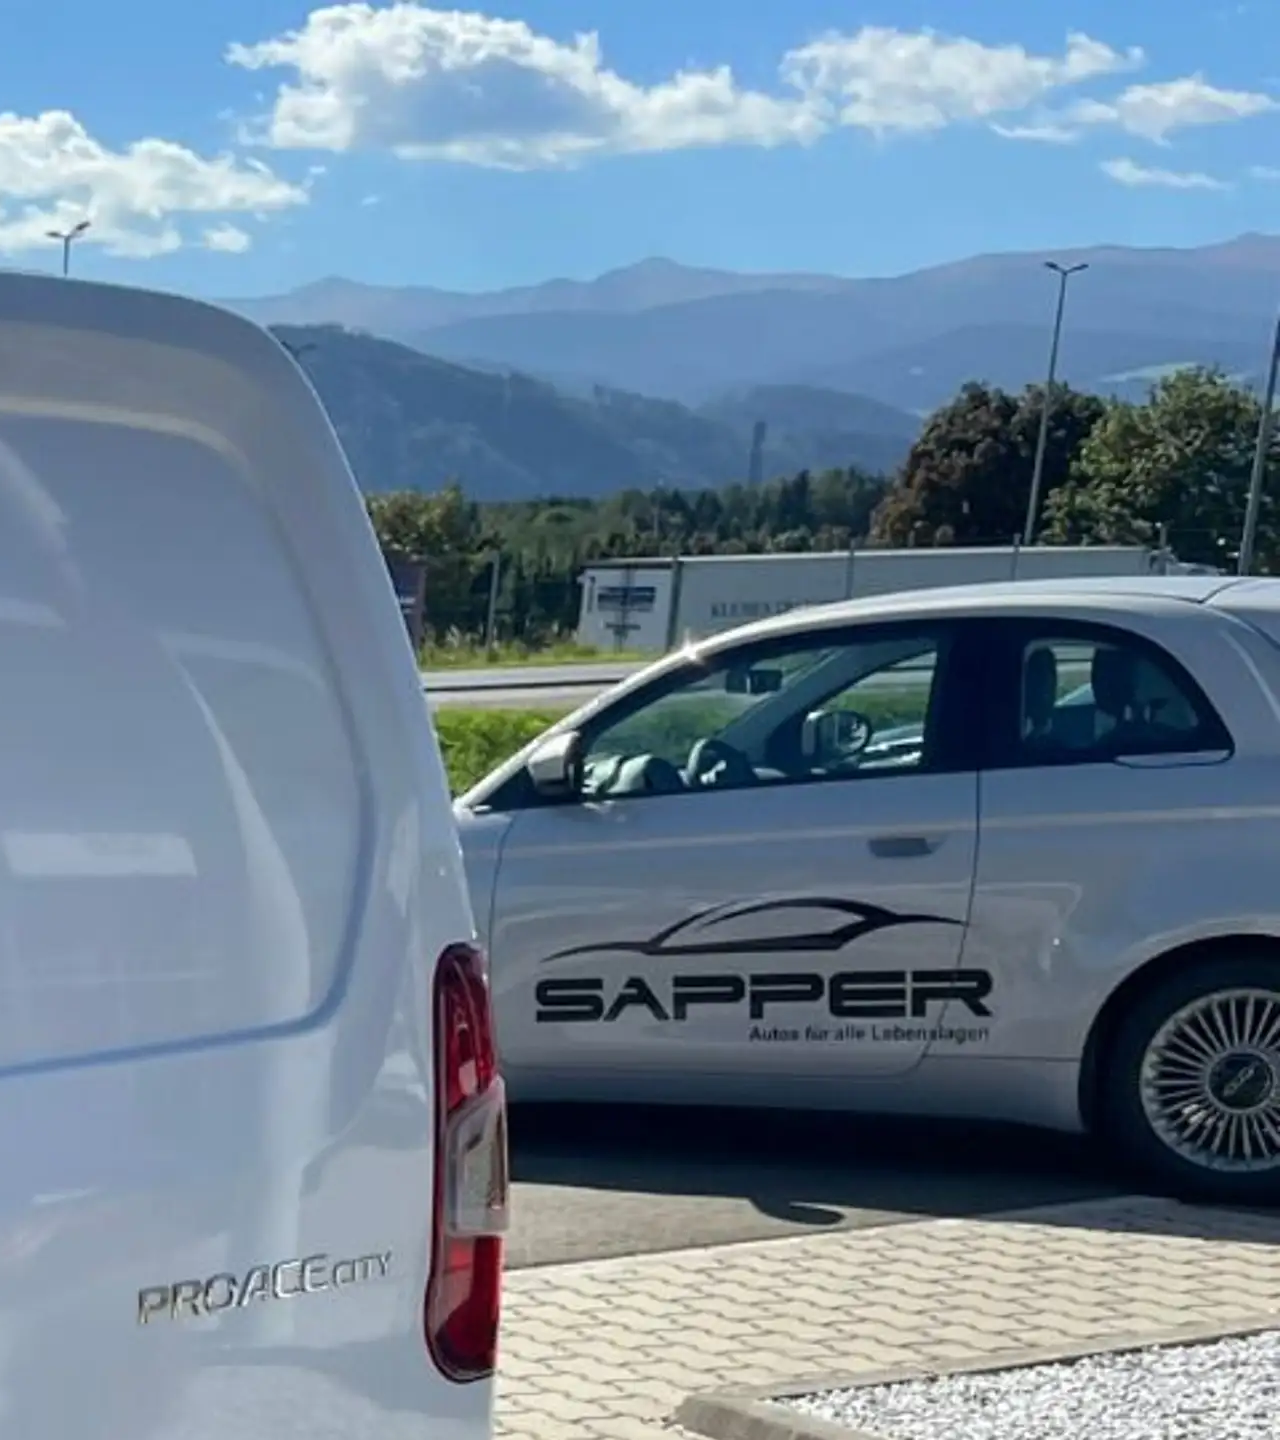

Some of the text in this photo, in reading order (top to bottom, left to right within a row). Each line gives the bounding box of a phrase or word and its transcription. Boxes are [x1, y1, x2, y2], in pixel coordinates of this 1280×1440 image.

[534, 968, 993, 1023] SAPPER
[749, 1025, 799, 1042] Autos
[834, 1024, 866, 1042] alle
[872, 1024, 990, 1045] Lebenslagen
[138, 1249, 393, 1325] PROACE CITY
